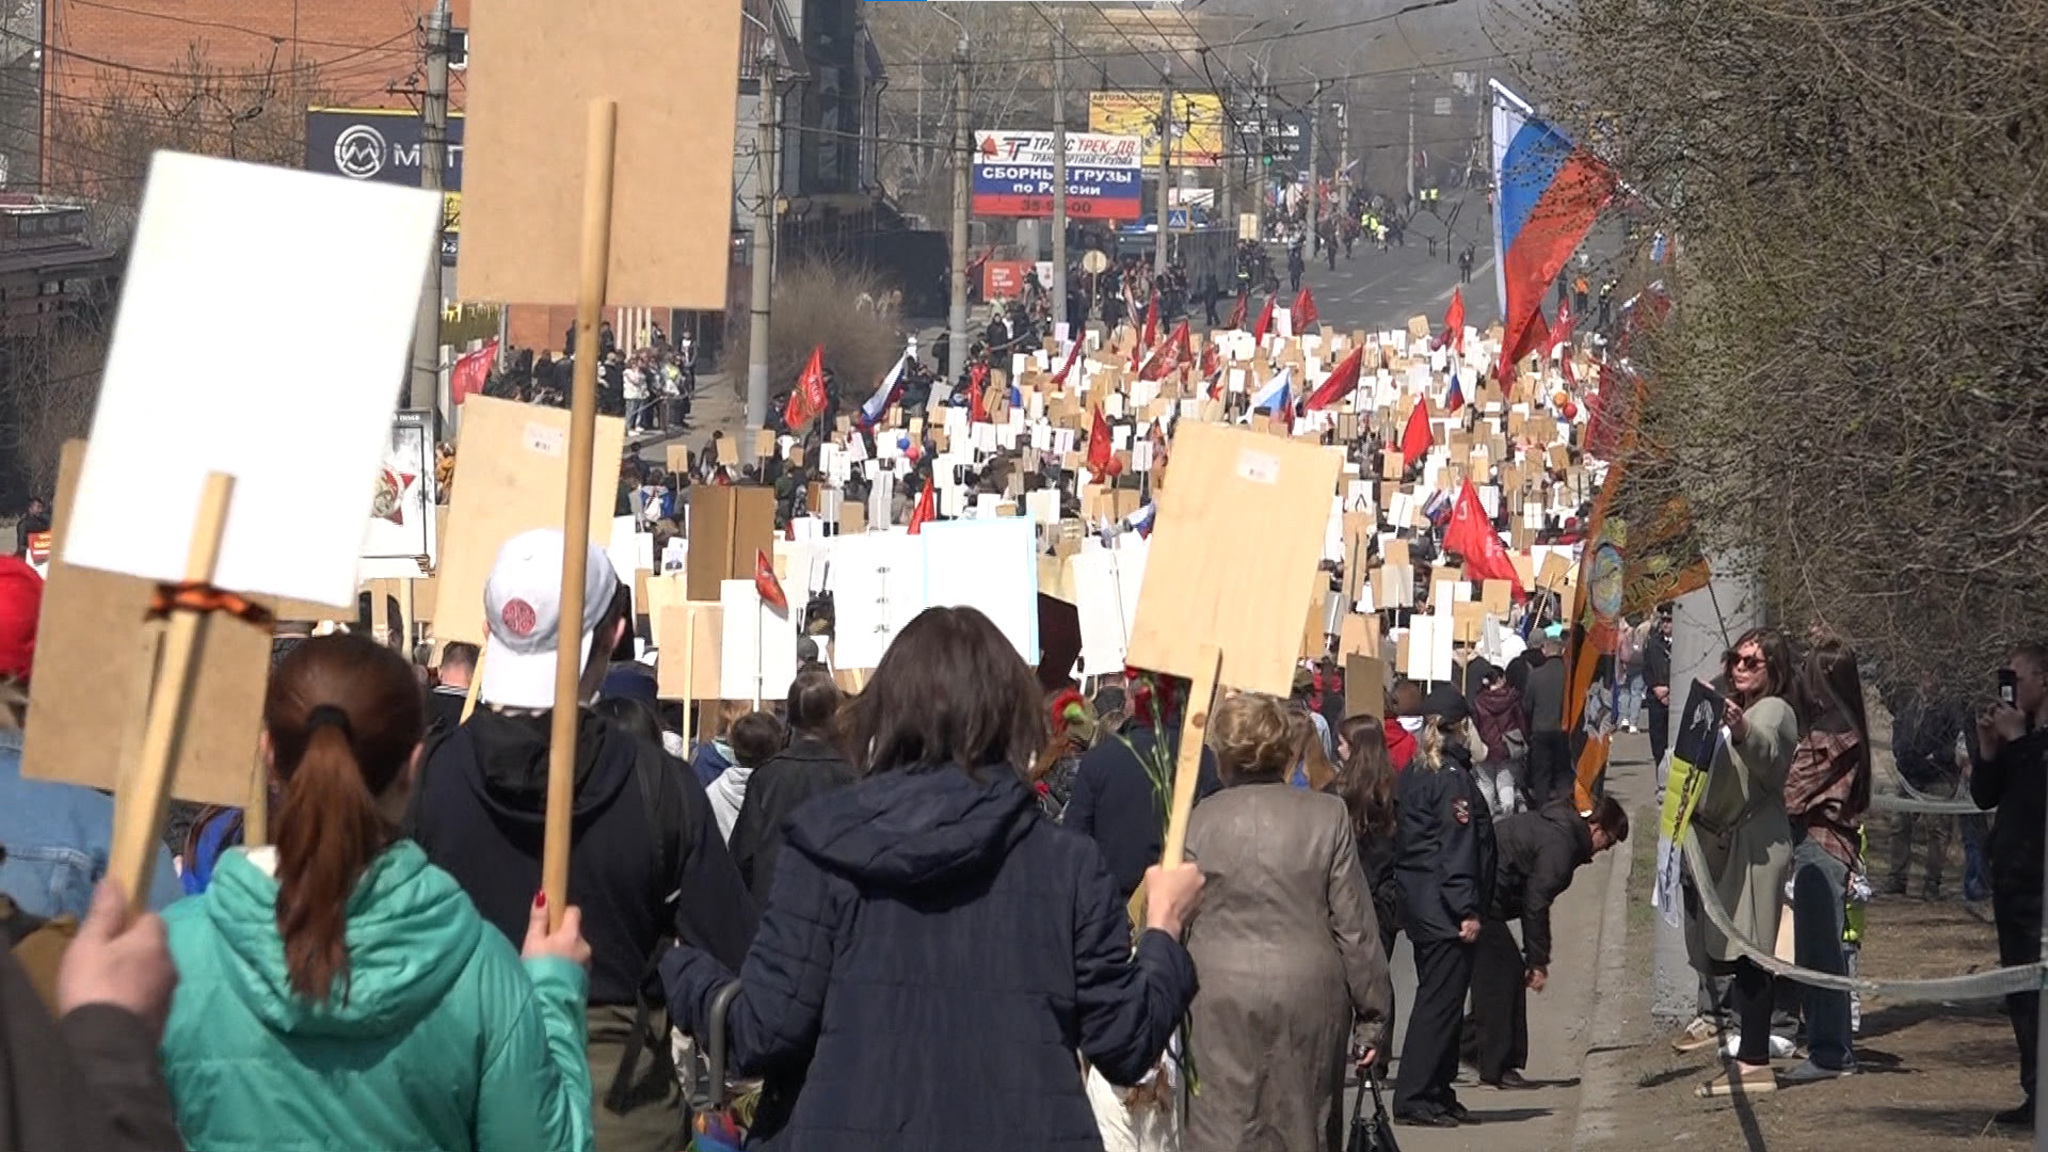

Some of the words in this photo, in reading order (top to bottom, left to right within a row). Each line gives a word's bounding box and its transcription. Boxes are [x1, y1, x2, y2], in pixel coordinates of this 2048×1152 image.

[1033, 137, 1075, 152] ТРАС
[1031, 153, 1096, 165] ТРАНРТНАЯ
[982, 167, 1070, 181] СБОРНЫ
[1075, 169, 1132, 183] ГРУЗЫ
[1021, 198, 1092, 214] 35--00
